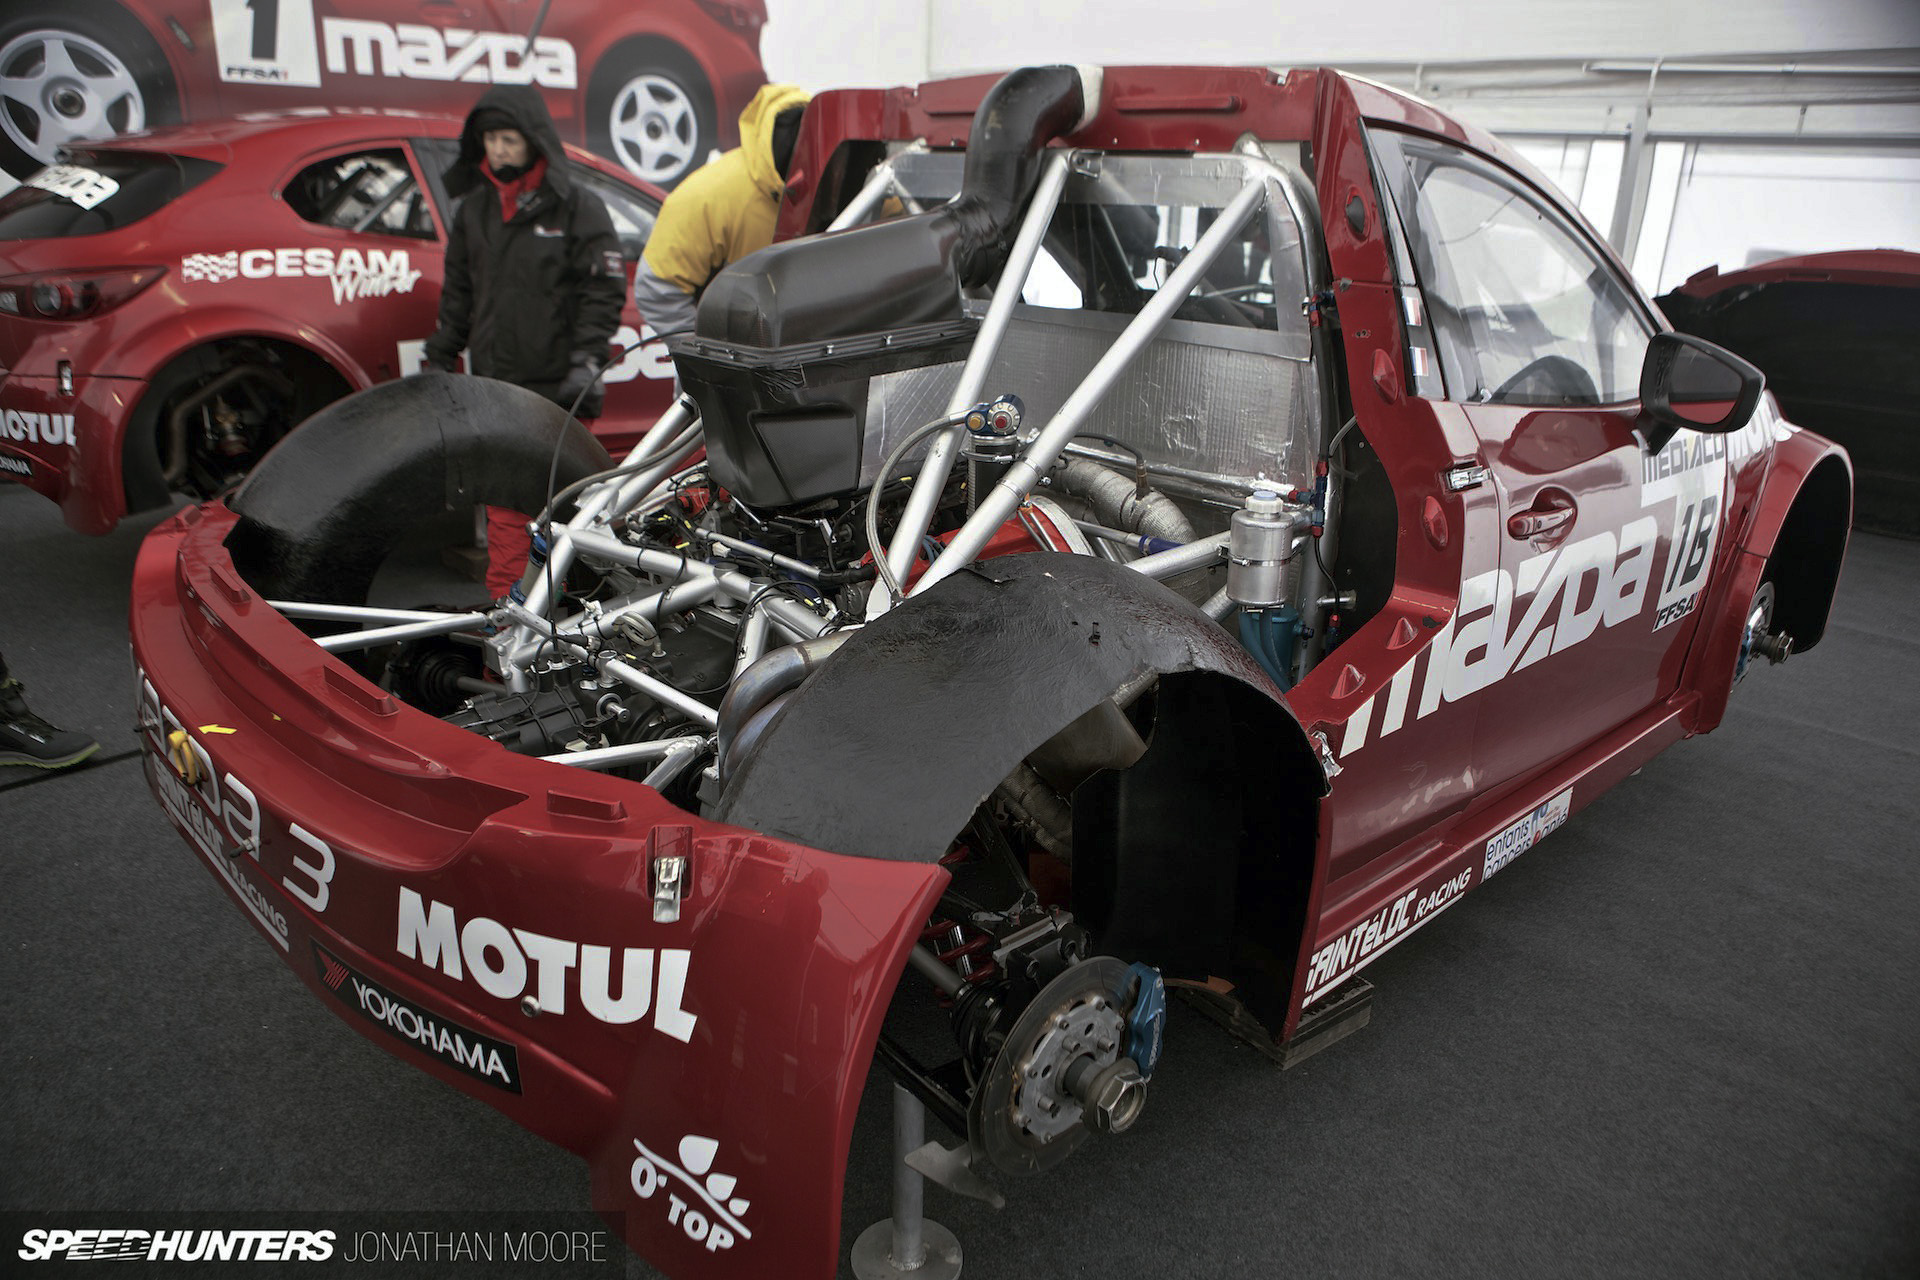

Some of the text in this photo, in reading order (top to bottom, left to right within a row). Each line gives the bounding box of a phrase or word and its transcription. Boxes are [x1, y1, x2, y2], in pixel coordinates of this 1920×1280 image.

[246, 0, 279, 60] 1
[322, 16, 578, 89] mazda
[240, 248, 409, 279] CESAM
[1339, 515, 1657, 759] mazda
[283, 822, 336, 913] 3
[1487, 820, 1529, 861] enfants
[229, 861, 289, 937] RACING
[1414, 867, 1472, 921] RACING
[397, 885, 698, 1044] MOTUL
[351, 976, 512, 1084] YOKOHAMA
[667, 1192, 735, 1253] TOP
